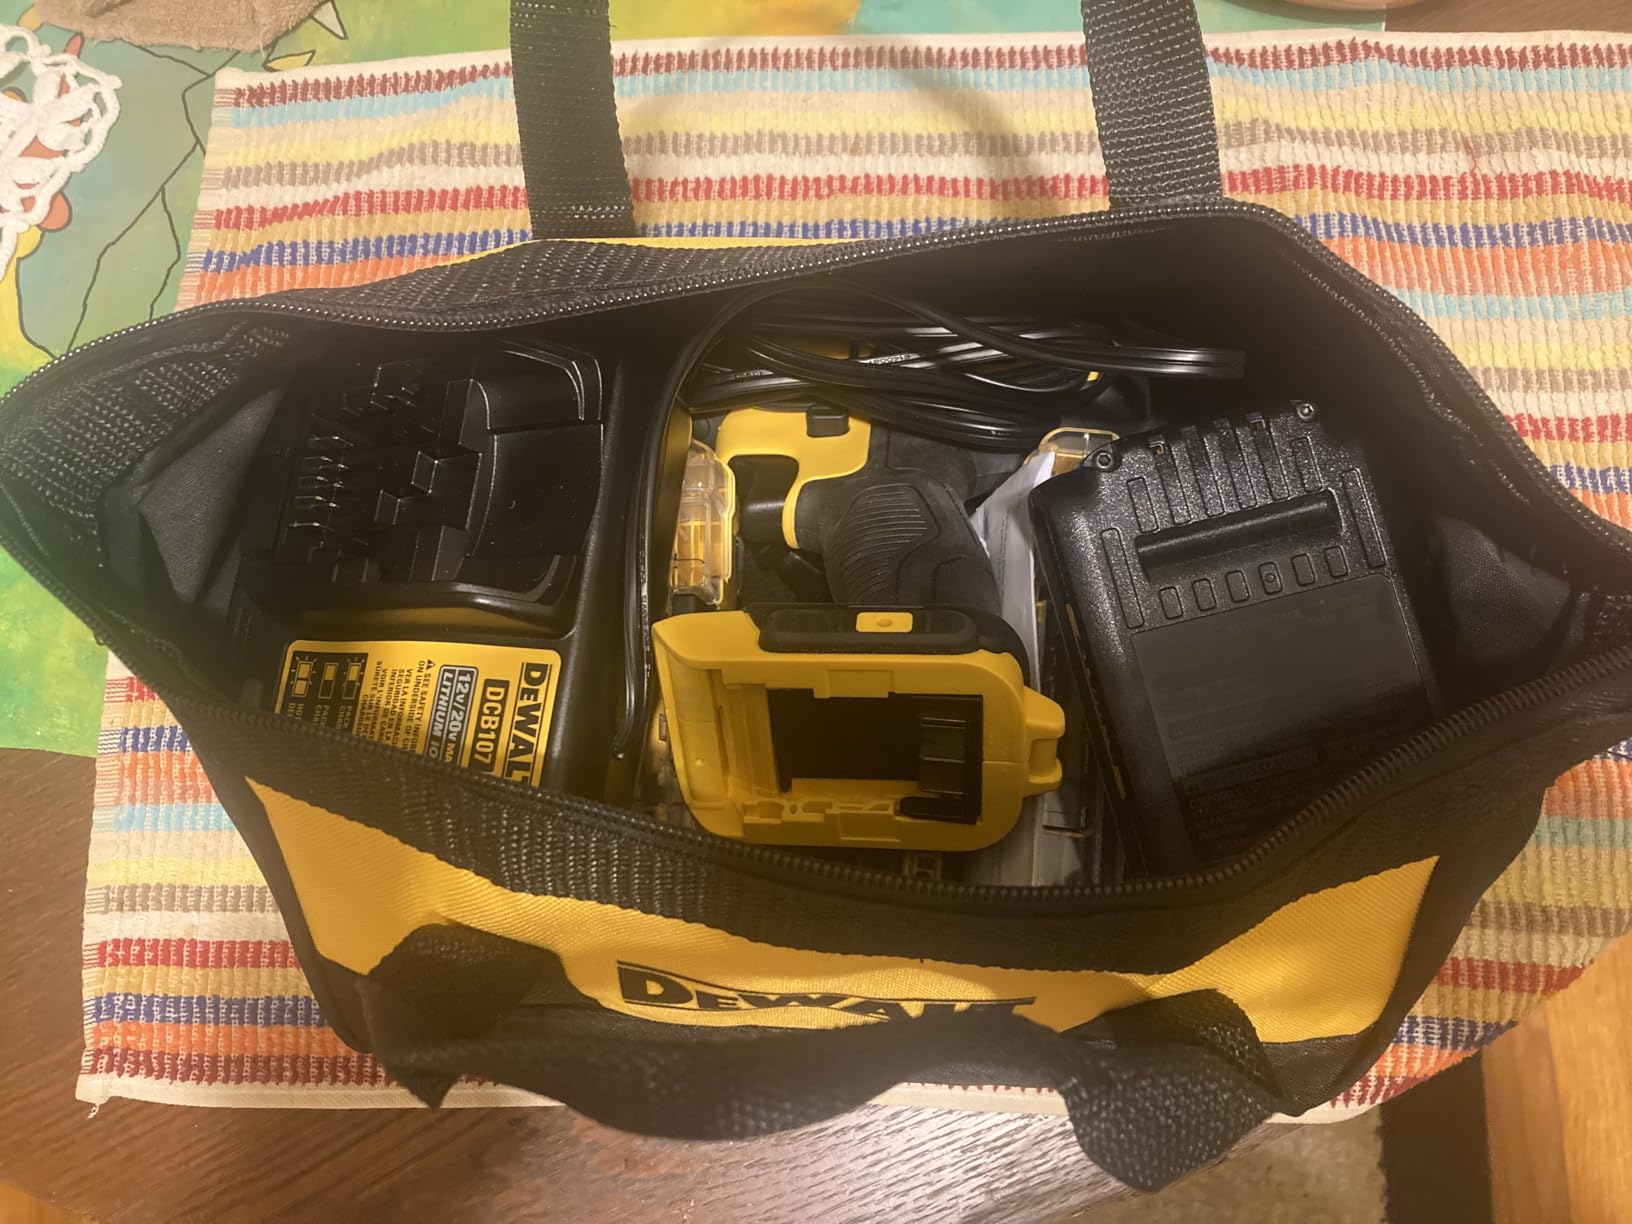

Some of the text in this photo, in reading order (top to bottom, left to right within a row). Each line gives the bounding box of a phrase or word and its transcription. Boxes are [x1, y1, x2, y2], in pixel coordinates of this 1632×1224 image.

[365, 712, 371, 720] LE
[367, 693, 375, 710] SUR
[368, 668, 387, 739] VOIR L'INFORMAT
[382, 708, 389, 717] DE
[385, 669, 398, 706] INFERIOR
[385, 669, 405, 741] SEGURIDAD EN LA
[392, 669, 413, 745] VER LA INFORMACI
[402, 661, 425, 750] ON UNDERSIDE OF CH
[410, 673, 431, 751] SEE SAFETY INFOR
[428, 671, 453, 759] LITHIUM IO
[504, 662, 551, 782] DEWAL
[445, 743, 456, 763] MA
[474, 687, 505, 764] DCB107
